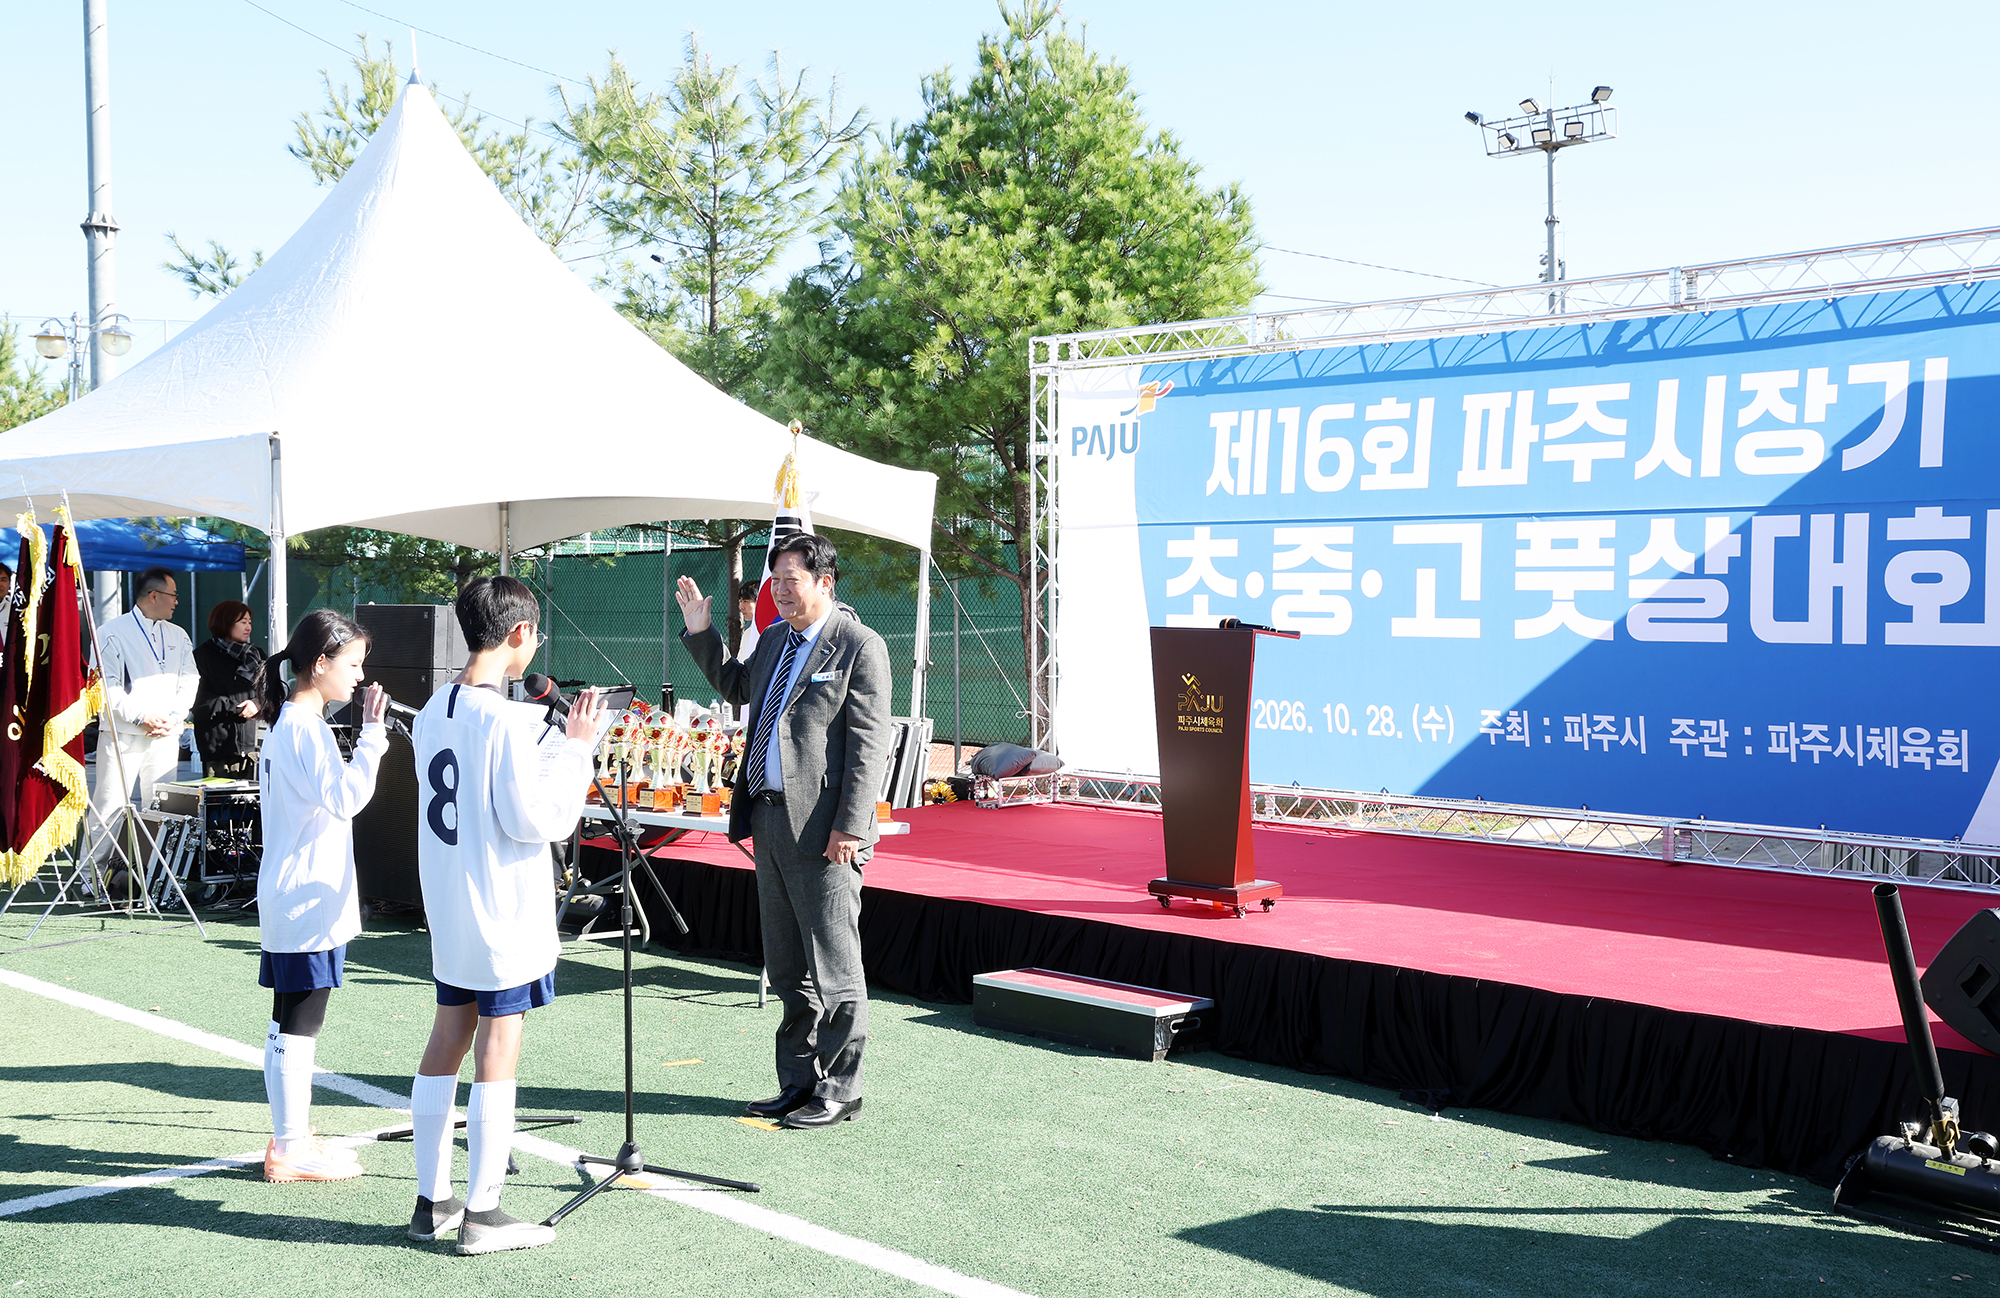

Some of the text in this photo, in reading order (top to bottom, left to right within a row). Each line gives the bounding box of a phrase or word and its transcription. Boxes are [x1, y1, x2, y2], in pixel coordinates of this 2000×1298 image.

[1071, 421, 1139, 462] PAJU
[1205, 356, 1949, 497] 제16회 파주시장기
[1514, 506, 2000, 647] 풋살대회
[1178, 694, 1224, 712] PAJU
[1178, 715, 1224, 727] 파주시체육회
[1253, 698, 1314, 734] 2026.
[1322, 702, 1358, 737] 10.
[1365, 704, 1403, 739] 28.
[1411, 703, 1455, 744] (수)
[1478, 709, 1531, 748] 주최
[1563, 712, 1647, 755] 파주시
[1669, 718, 1729, 759] 주관
[1767, 721, 1969, 773] 파주시체육회
[427, 748, 460, 846] 8
